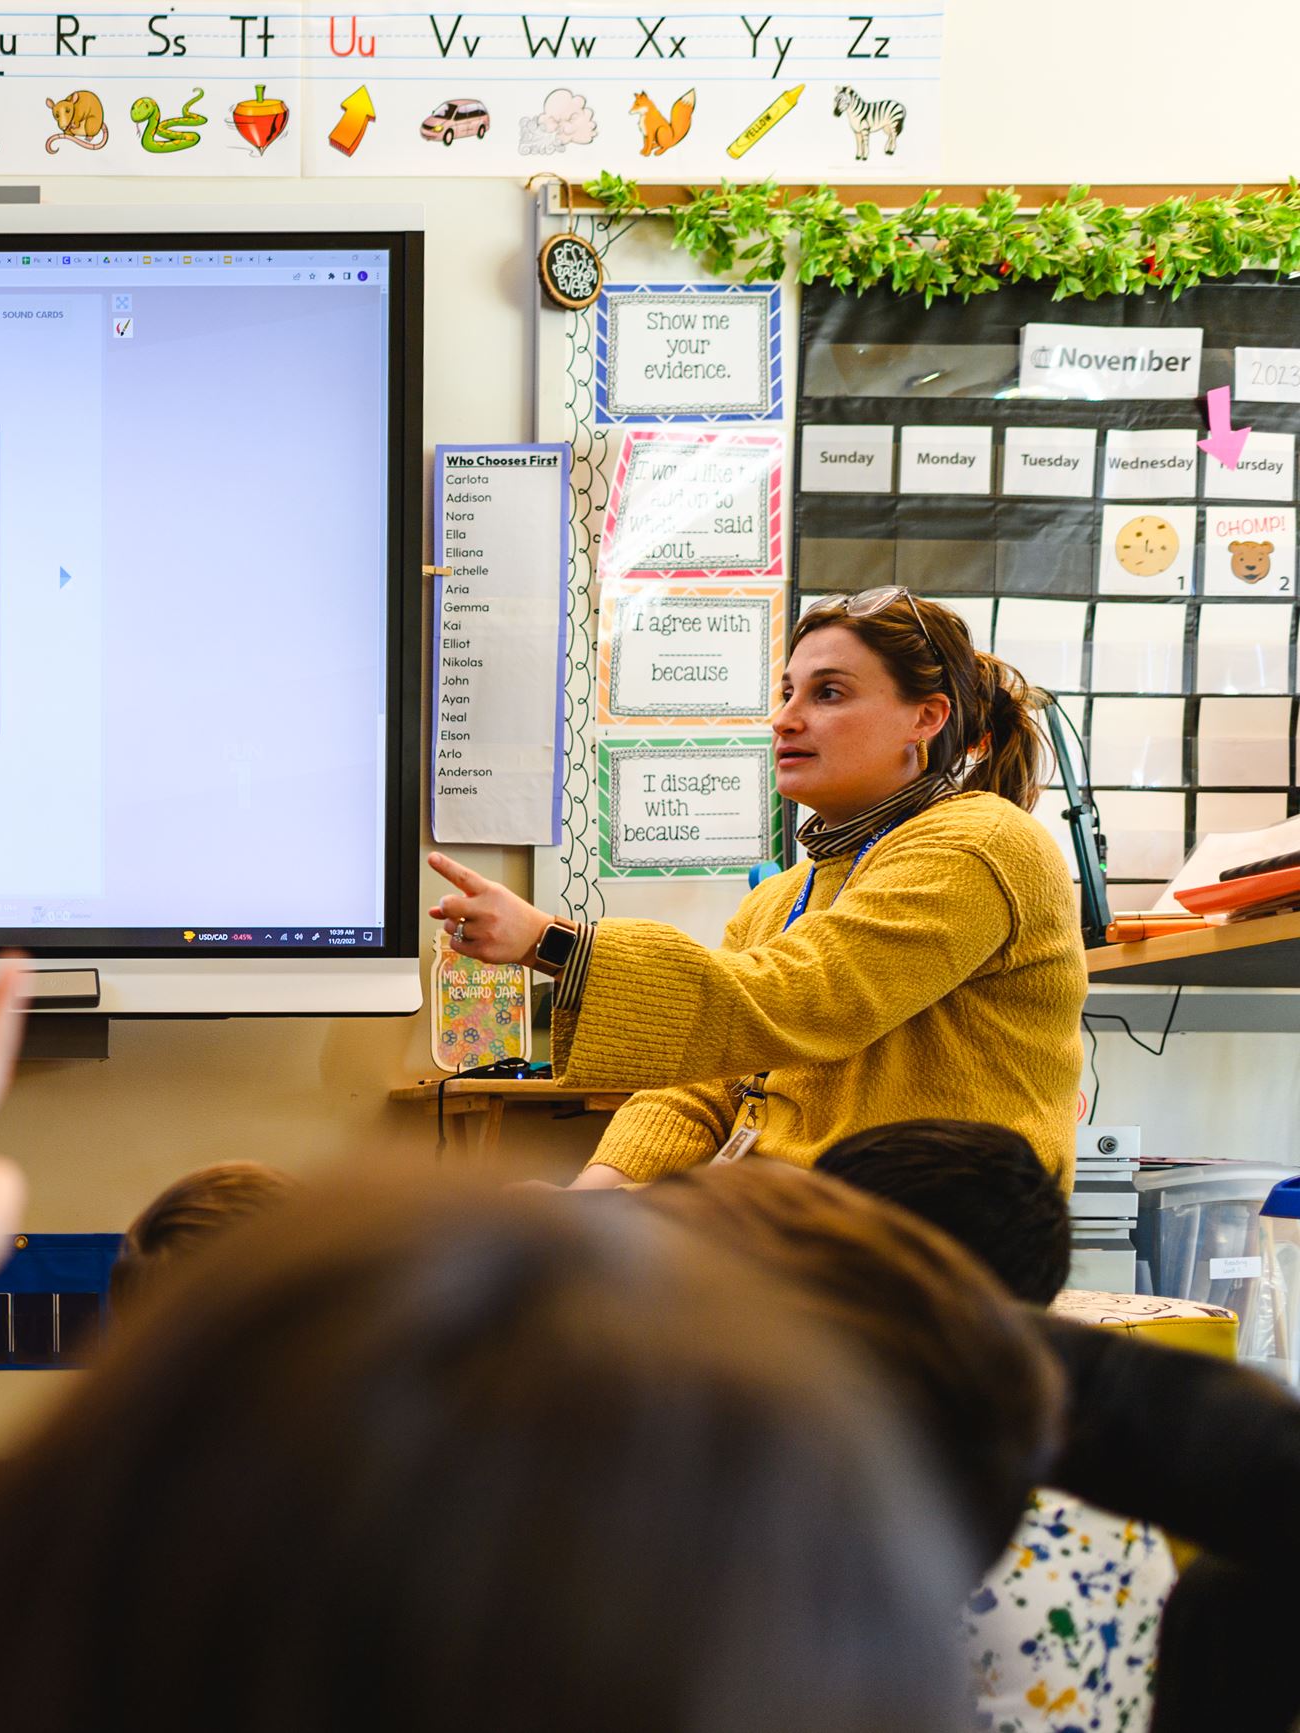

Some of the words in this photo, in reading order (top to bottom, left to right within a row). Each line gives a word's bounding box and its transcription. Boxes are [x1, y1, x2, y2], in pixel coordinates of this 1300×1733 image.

[56, 15, 96, 57] Rr
[148, 15, 187, 57] Ss
[229, 17, 275, 58] Tt
[329, 17, 375, 58] Uu
[430, 15, 481, 58] Vv
[522, 16, 596, 58] Ww
[635, 17, 686, 59] Xx
[740, 16, 793, 79] Yy
[846, 17, 890, 58] Zz
[744, 112, 772, 141] YELLOW
[2, 310, 34, 319] SOUND
[36, 310, 64, 319] CARDS
[647, 312, 699, 330] Show
[702, 315, 730, 330] me
[666, 338, 710, 358] your
[1058, 346, 1191, 373] November
[644, 361, 731, 379] evidence.
[1251, 361, 1300, 387] 2023
[446, 456, 474, 466] Who
[477, 455, 527, 466] Chooses
[529, 455, 558, 466] First
[819, 450, 875, 467] Sunday
[917, 451, 977, 468] Monday
[1021, 453, 1080, 470] Tuesday
[1108, 454, 1194, 473] Wednesday
[446, 474, 489, 485] Carlota
[446, 493, 492, 503] Addison
[446, 511, 474, 521] Nora
[714, 515, 753, 534] said
[1216, 516, 1286, 537] CHOMP!
[446, 529, 466, 540] Ella
[446, 547, 483, 558] Elliana
[446, 565, 489, 576] ichelle
[445, 584, 470, 594] Aria
[1178, 576, 1185, 590] 1
[1279, 576, 1290, 591] 2
[444, 602, 489, 613] Gemma
[443, 620, 461, 631] Kai
[632, 613, 644, 632] I
[649, 616, 702, 636] agree
[707, 613, 751, 632] with
[443, 638, 470, 649] Elliot
[442, 656, 483, 668] Nikolas
[651, 663, 729, 682] because
[442, 675, 469, 686] John
[441, 694, 470, 706] Ayan
[441, 712, 467, 723] Neal
[440, 730, 470, 741] Elson
[439, 748, 462, 759] Arlo
[438, 766, 492, 777] Anderson
[438, 784, 478, 795] Jameis
[643, 774, 656, 793] I
[661, 773, 741, 795] disagree
[645, 798, 689, 817] with
[623, 823, 700, 842] because
[199, 933, 228, 941] USD/CAD
[443, 970, 469, 985] MRS.
[471, 969, 522, 985] ABRAM'S
[449, 985, 492, 1000] REWARD
[494, 984, 520, 999] JAR
